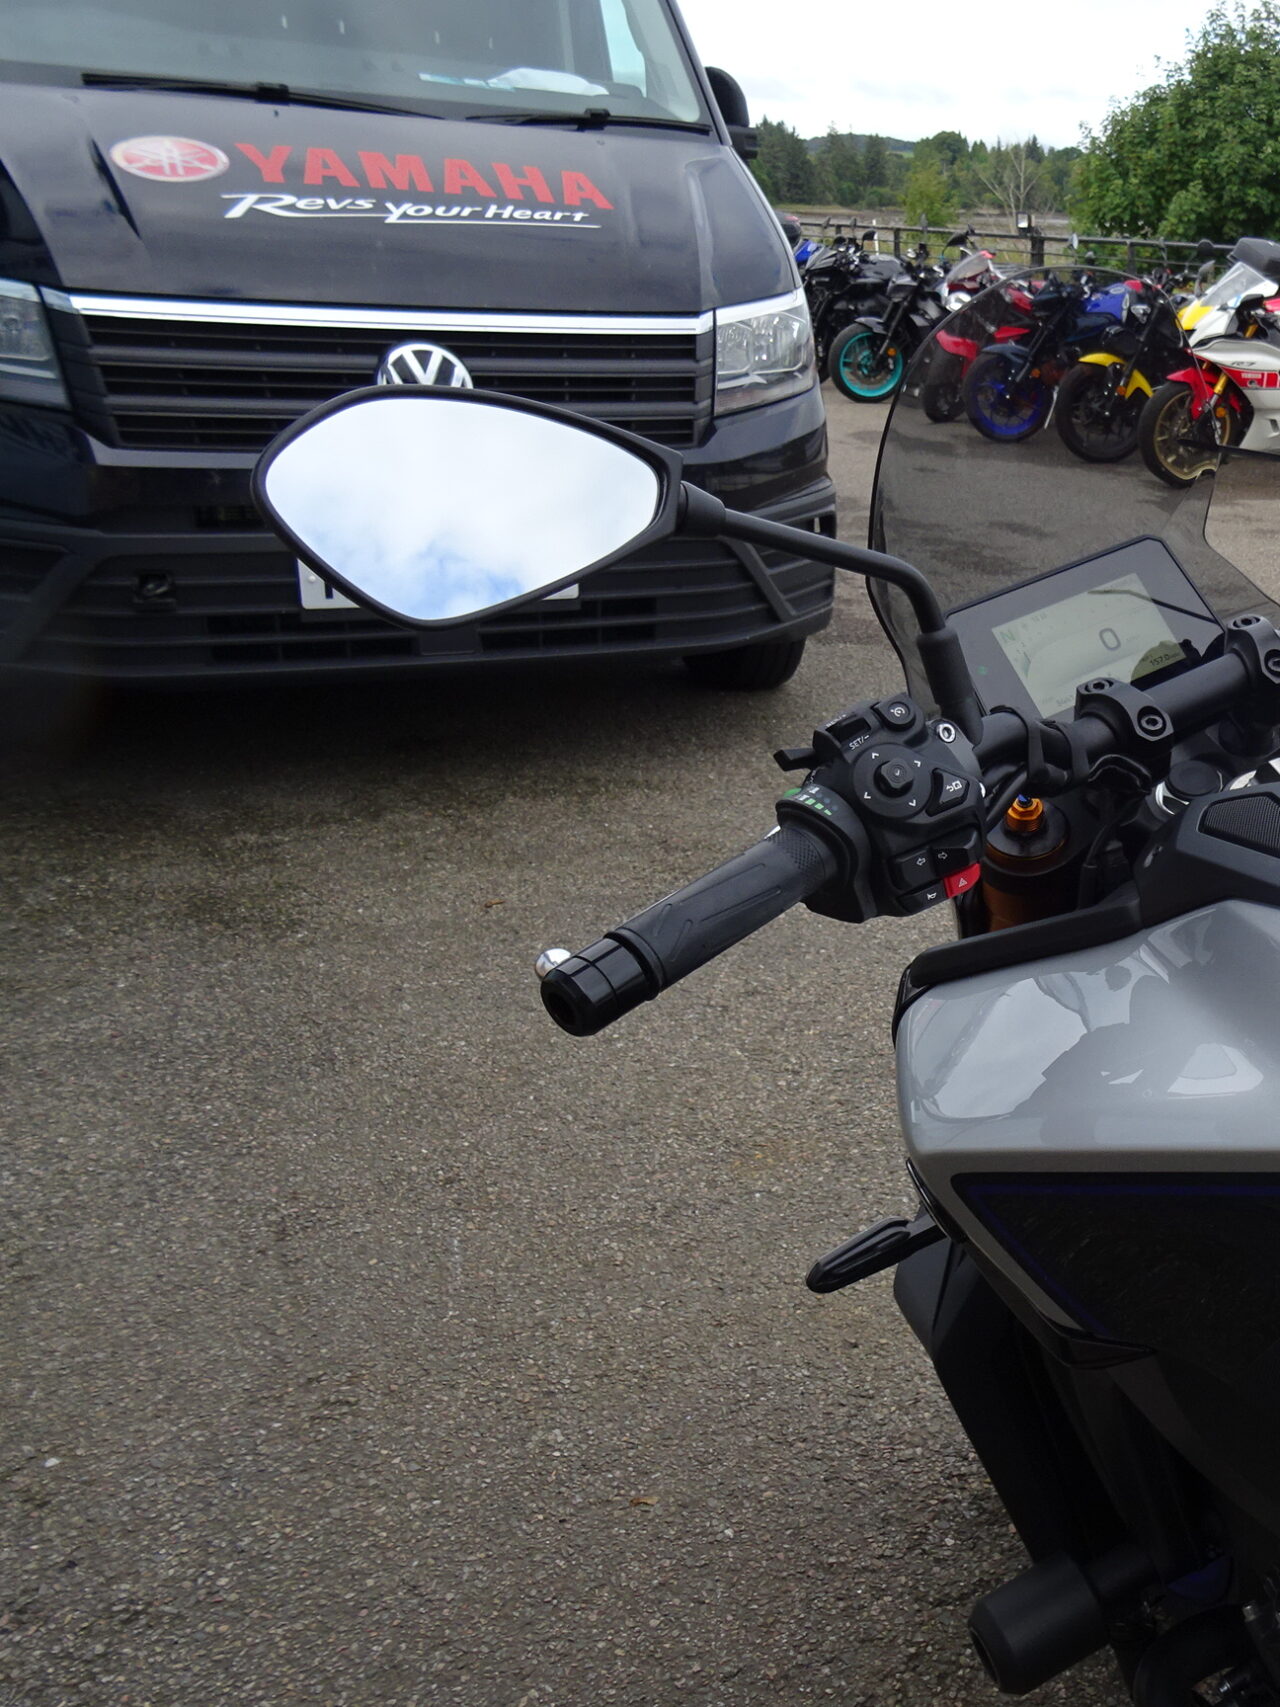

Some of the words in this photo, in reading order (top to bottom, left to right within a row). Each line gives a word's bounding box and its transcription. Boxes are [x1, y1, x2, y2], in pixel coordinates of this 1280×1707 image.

[235, 142, 614, 210] YAMAHA
[220, 193, 377, 219] Revs
[484, 203, 590, 222] Heart
